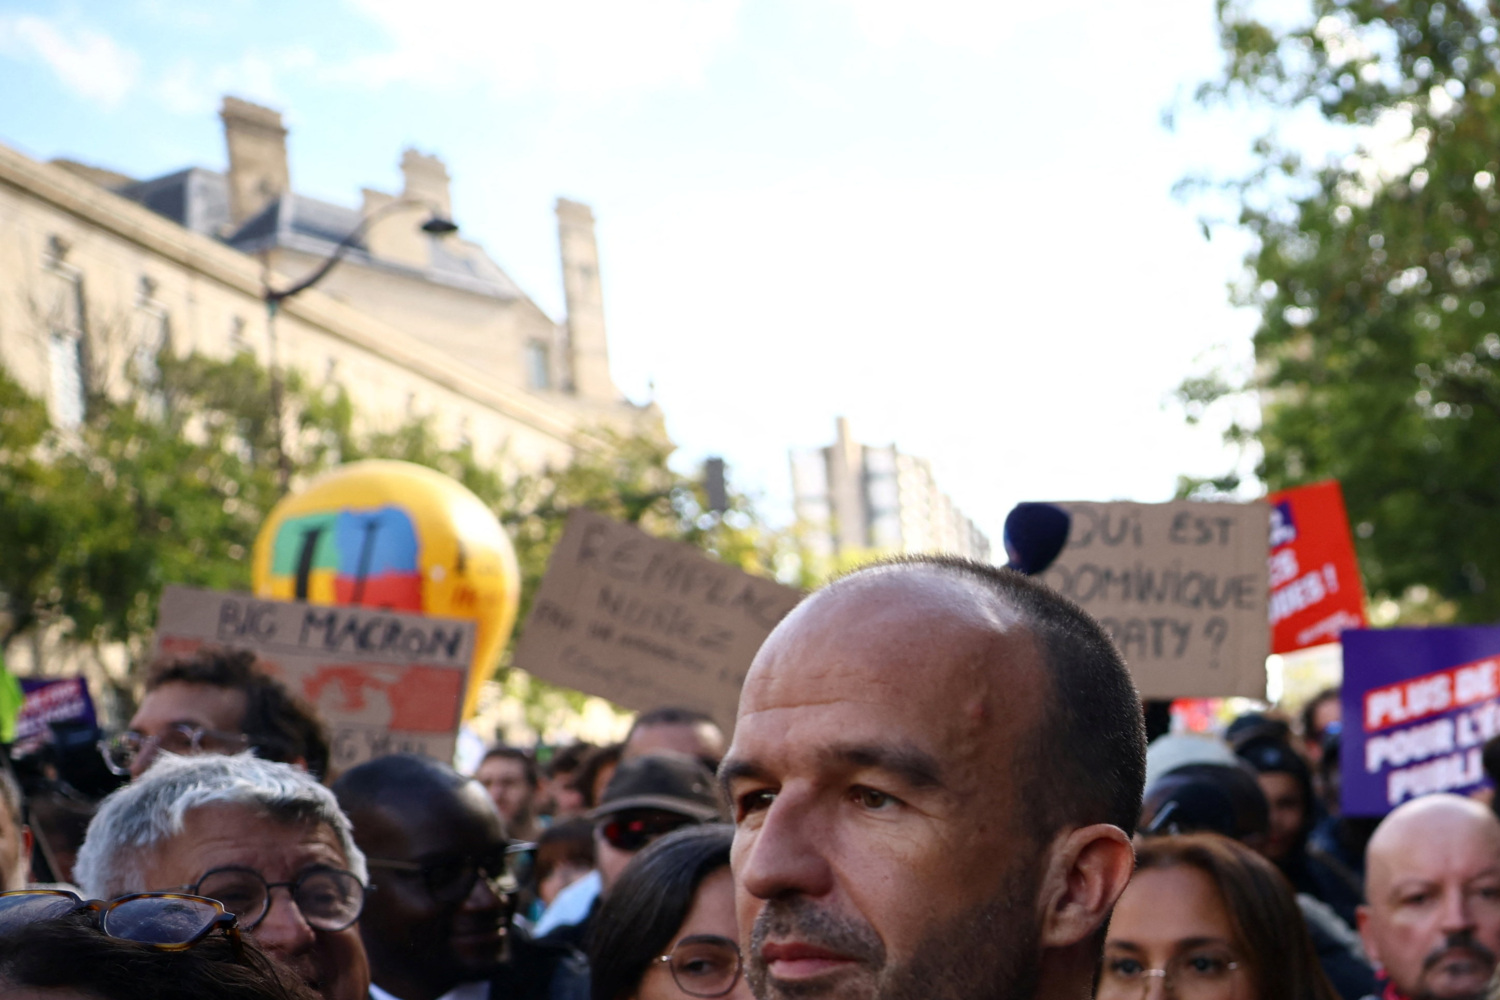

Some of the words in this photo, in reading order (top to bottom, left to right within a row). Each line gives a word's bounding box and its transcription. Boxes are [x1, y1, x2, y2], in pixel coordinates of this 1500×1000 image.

[1167, 509, 1237, 546] EST
[576, 519, 784, 629] REMPLAC
[216, 595, 278, 644] BIG
[298, 606, 464, 660] MACRON
[1203, 614, 1230, 670] ?
[1364, 674, 1453, 730] PLUS
[1453, 660, 1499, 704] DE
[1364, 717, 1456, 774] POUR
[1386, 747, 1484, 807] PUBLI
